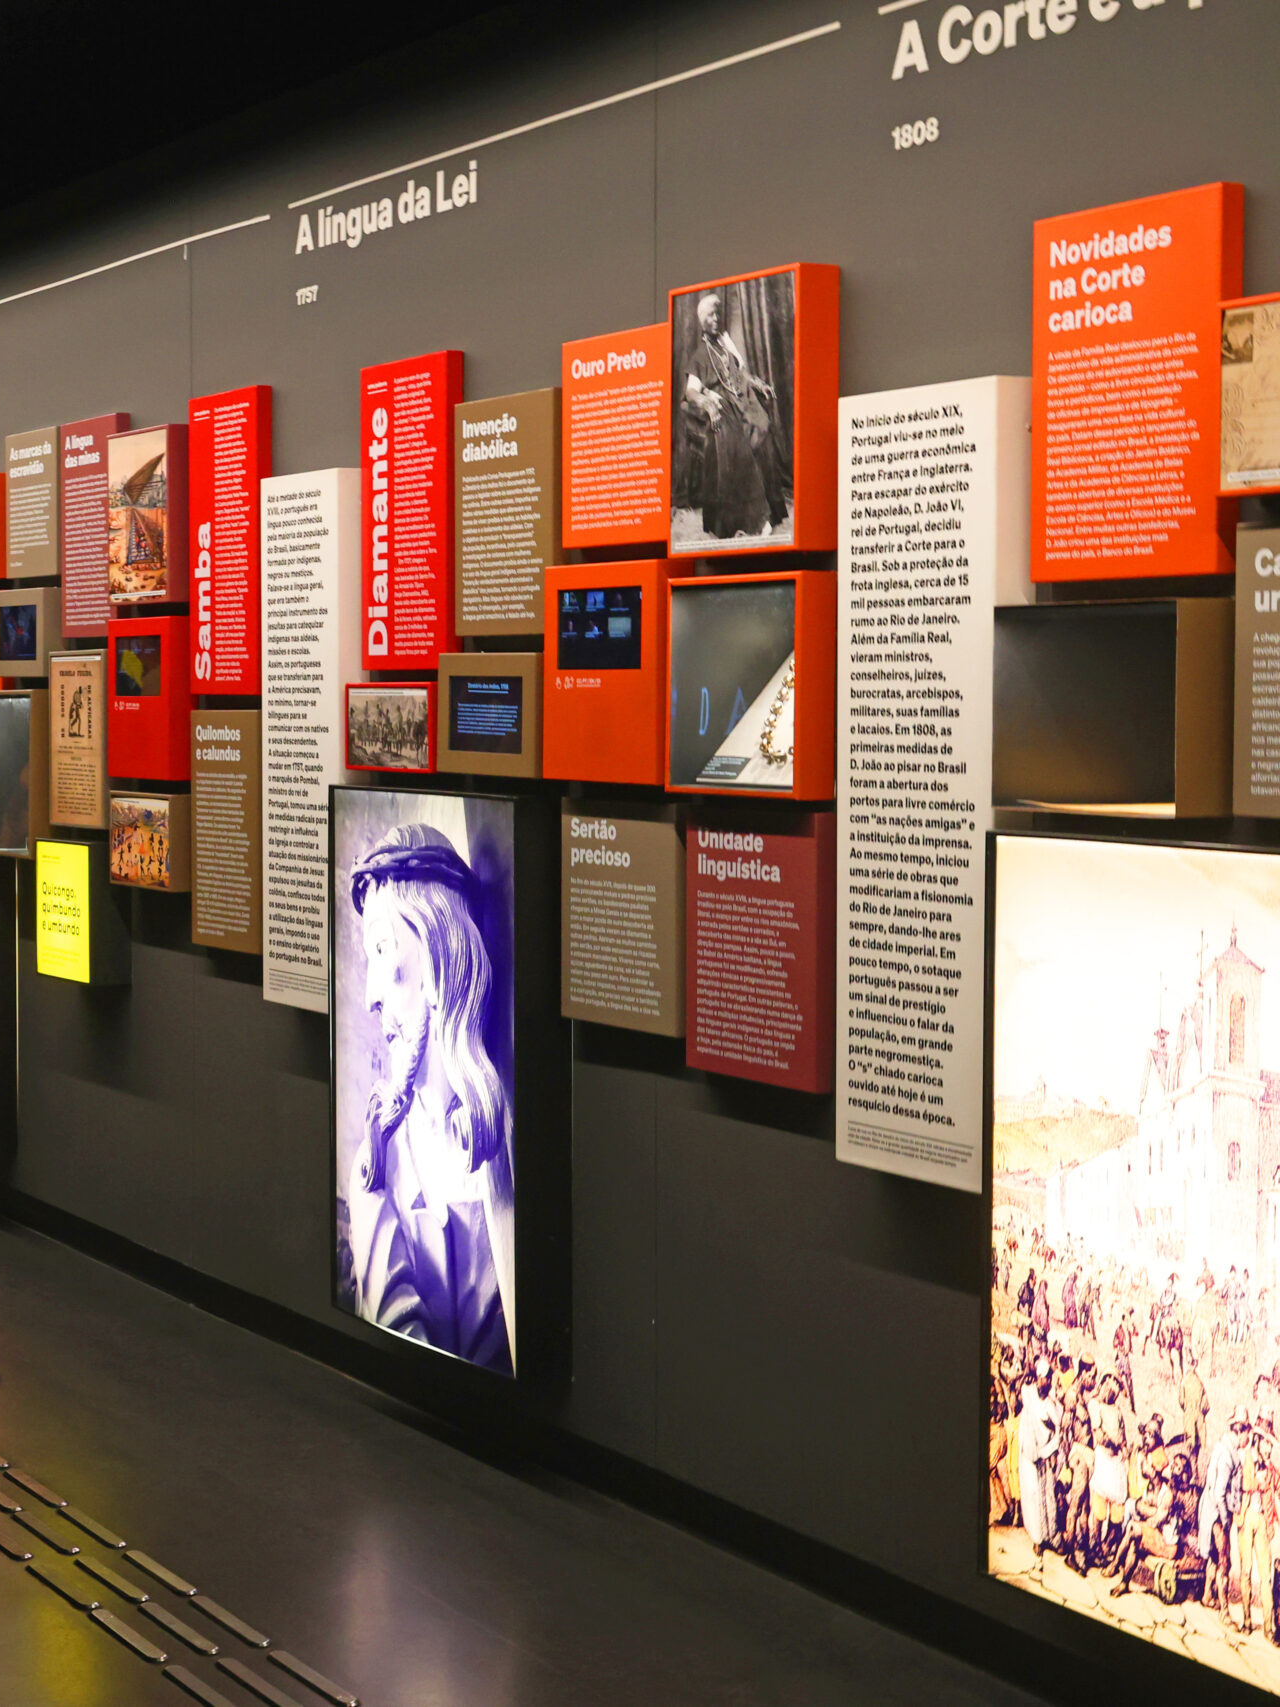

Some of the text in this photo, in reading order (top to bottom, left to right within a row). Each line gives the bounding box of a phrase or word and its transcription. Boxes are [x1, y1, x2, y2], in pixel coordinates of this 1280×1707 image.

[892, 19, 929, 80] A
[938, 0, 1078, 64] Corte
[892, 117, 940, 150] 1808
[295, 159, 478, 255] A língua da Lei
[1049, 224, 1172, 267] Novidades
[1049, 261, 1145, 300] na Corte
[1048, 300, 1133, 333] carioca
[571, 349, 646, 380] Ouro Preto
[462, 413, 517, 439] Invenção
[851, 417, 864, 430] No
[866, 414, 892, 428] início
[893, 412, 906, 424] do
[907, 407, 939, 423] século
[10, 440, 52, 461] As marcas da
[65, 434, 93, 450] A língua
[462, 439, 518, 463] diabólica
[851, 441, 976, 466] de uma guerra econômica
[10, 460, 44, 478] escravidão
[65, 451, 100, 468] das minas
[851, 479, 969, 502] Para escapar do exército
[368, 407, 388, 656] Diamante
[850, 579, 873, 592] frota
[913, 577, 941, 589] cerca
[943, 574, 956, 587] de
[958, 573, 969, 587] 15
[195, 522, 211, 681] Samba
[850, 594, 971, 611] mil pessoas embarcaram
[850, 632, 875, 645] Além
[876, 632, 889, 645] da
[890, 631, 926, 644] Família
[195, 724, 241, 742] Quilombos
[850, 725, 856, 735] e
[894, 723, 910, 736] Em
[940, 726, 952, 737] as
[195, 744, 241, 762] e calundus
[860, 758, 882, 772] João
[883, 761, 895, 772] ao
[897, 759, 921, 774] pisar
[923, 763, 936, 773] no
[937, 760, 966, 775] Brasil
[849, 794, 975, 813] portos para livre comércio
[570, 817, 617, 841] Sertão
[697, 828, 763, 853] Unidade
[849, 831, 855, 841] a
[856, 829, 906, 847] instituição
[907, 833, 920, 846] da
[570, 844, 631, 868] precioso
[697, 853, 781, 883] linguística
[41, 900, 81, 918] quimbundo
[41, 918, 81, 936] e umbundo
[848, 990, 946, 1016] um sinal de prestígio
[848, 1043, 873, 1057] parte
